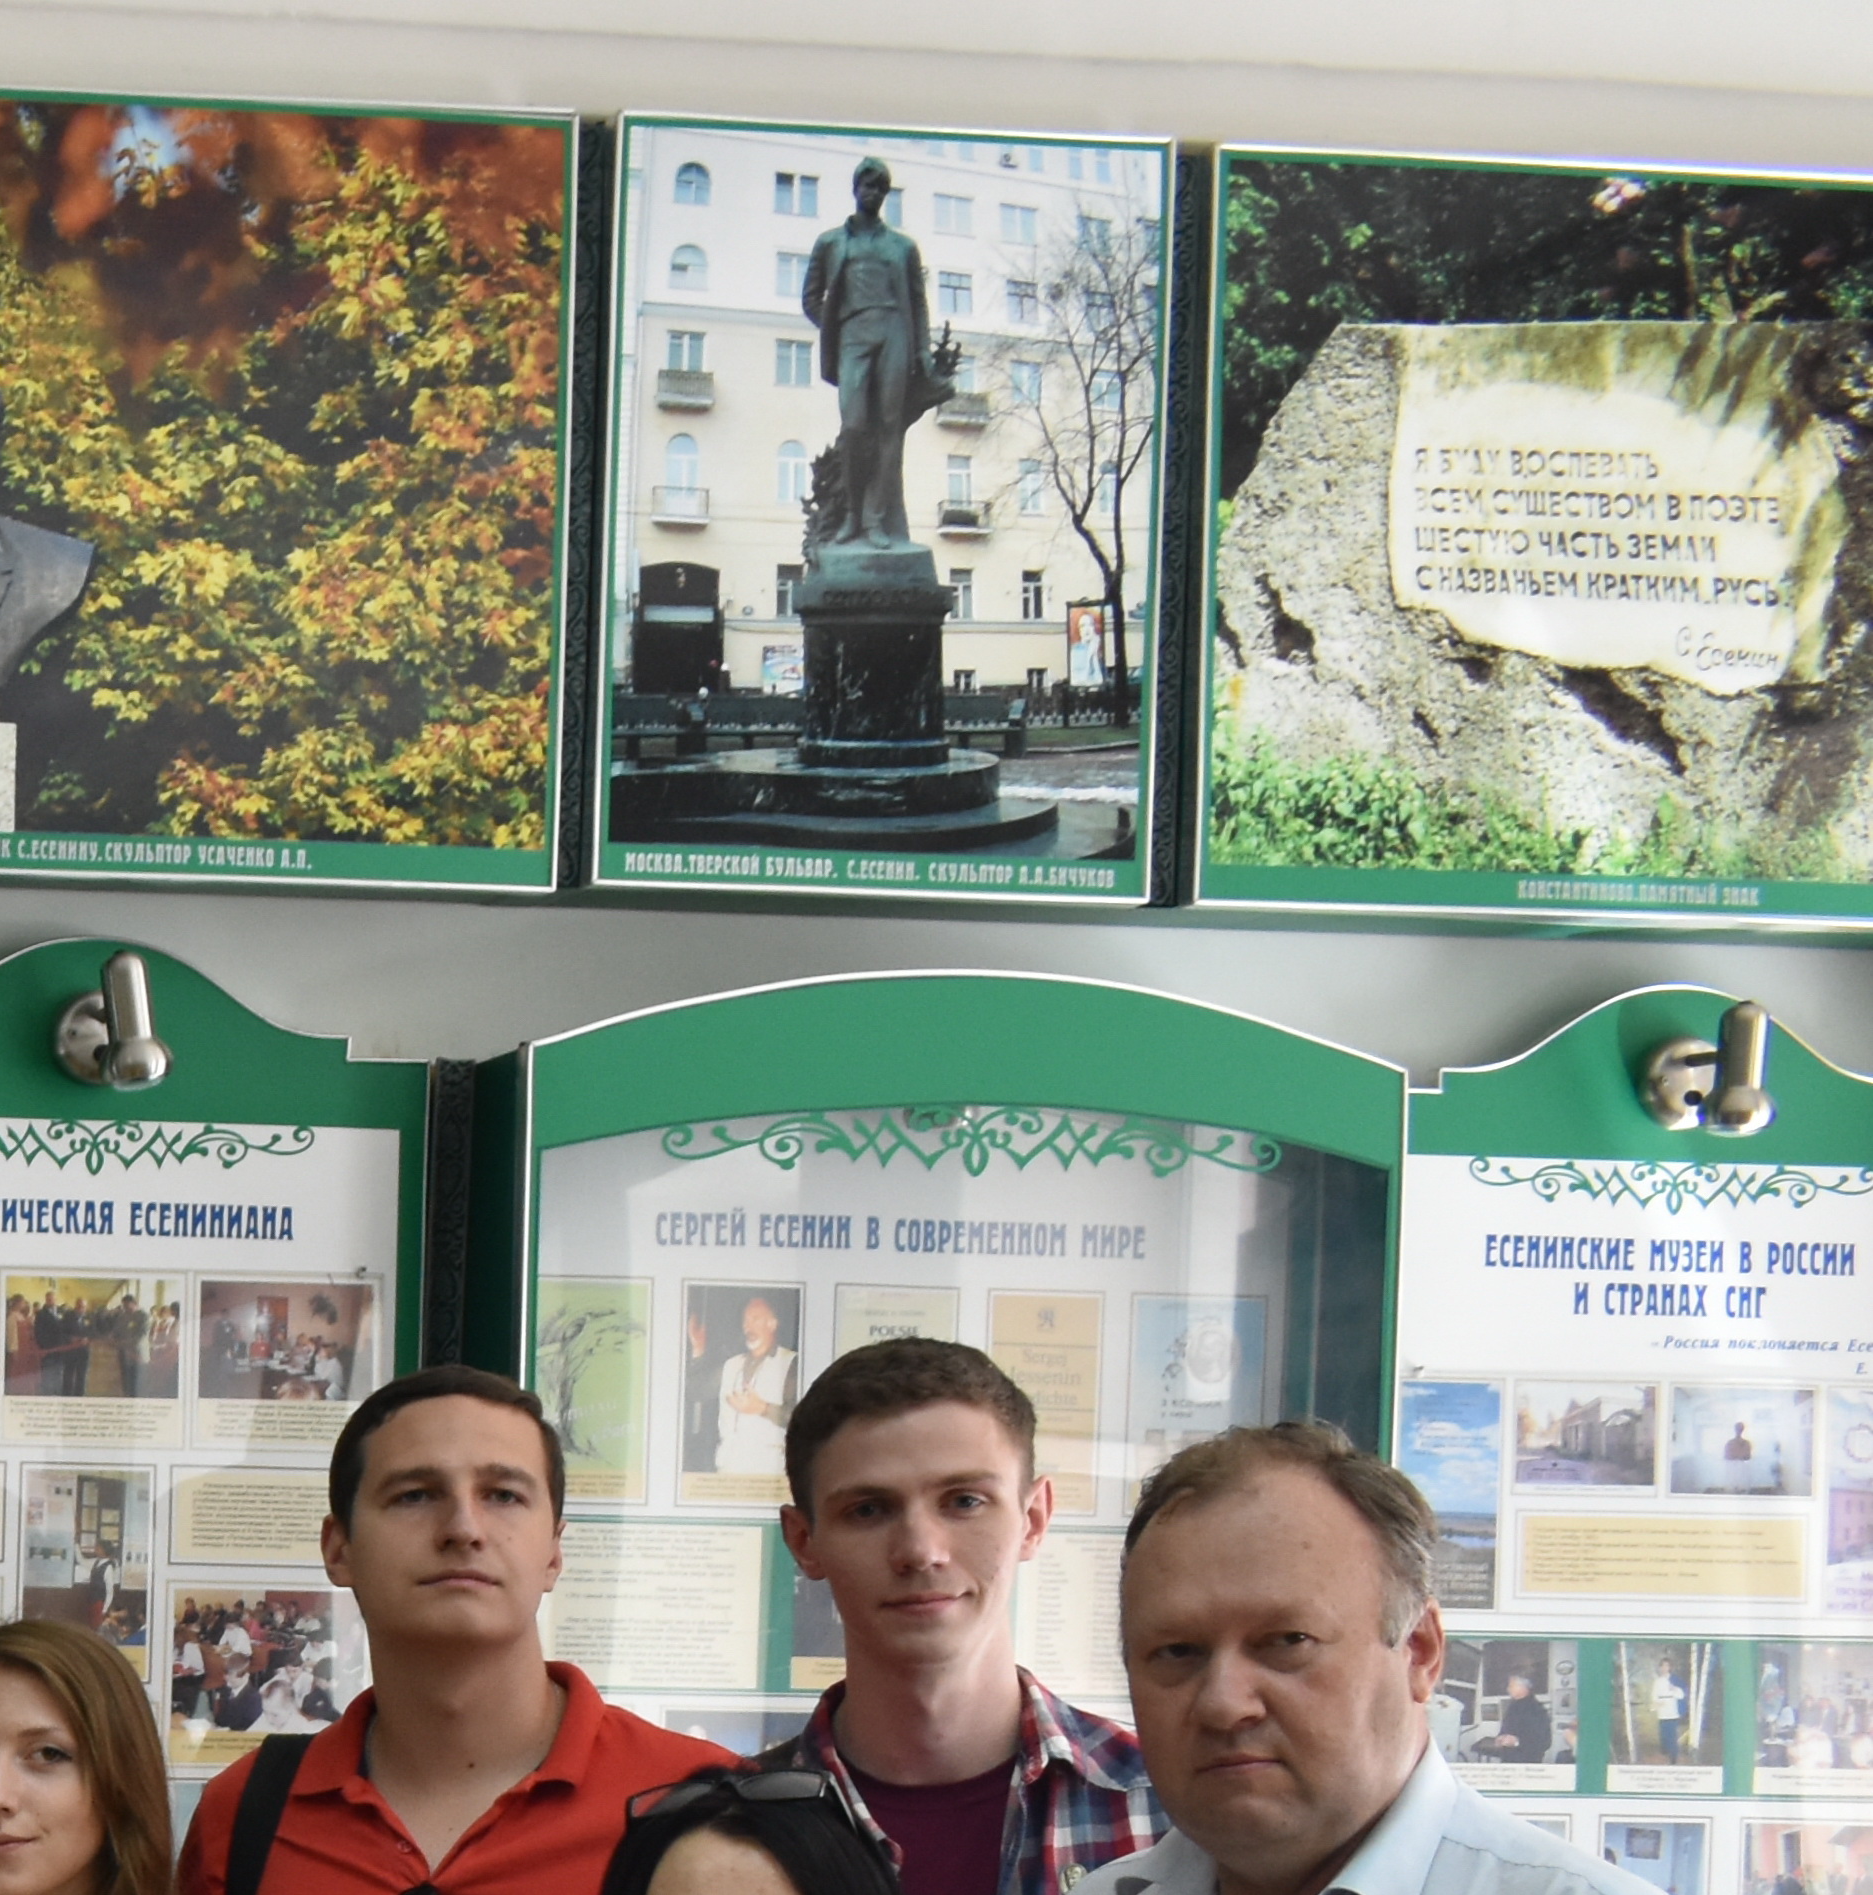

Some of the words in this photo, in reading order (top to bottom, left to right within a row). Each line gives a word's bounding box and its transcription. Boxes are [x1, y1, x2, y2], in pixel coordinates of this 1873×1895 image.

[1415, 448, 1429, 475] Я
[1438, 448, 1500, 476] БУДУ
[1510, 449, 1659, 481] ВОСПЕВАТЬ
[1415, 487, 1483, 516] ВСЕМ
[1492, 489, 1656, 522] СУЩЕСТВОМ
[1666, 494, 1682, 521] В
[1689, 494, 1782, 526] ПОЭТЕ
[1415, 528, 1530, 557] ШЕСТУЮ
[1539, 532, 1621, 560] ЧАСТЬ
[1627, 534, 1718, 563] ЗЕМЛИ
[1415, 565, 1433, 592] С
[1439, 566, 1579, 600] НАЗВАНЬЕМ
[1586, 572, 1700, 603] КРАТКИМ
[198, 844, 275, 868] УСАЧЕНКО
[280, 847, 313, 870] А.П.
[765, 855, 838, 879] БУЛЬВАР.
[846, 859, 921, 881] С.ЕСЕНИН.
[927, 861, 1013, 884] СКУЛЬПТОР
[1018, 865, 1115, 889] А.А.БИЧУКОВ
[1722, 885, 1760, 906] ЗНАК
[129, 1200, 294, 1241] ЕСЕНИНИАНА
[655, 1207, 746, 1248] СЕРГЕЙ
[758, 1212, 851, 1250] ЕСЕНИН
[866, 1216, 881, 1249] В
[894, 1215, 1068, 1258] СОВРЕМЕННОМ
[1081, 1223, 1146, 1260] МИРЕ
[1484, 1233, 1636, 1271] ЕСЕНИНСКИЕ
[1648, 1238, 1725, 1274] МУЗЕИ
[1739, 1241, 1753, 1275] В
[1767, 1241, 1856, 1277] РОССИИ
[1573, 1282, 1589, 1315] И
[1604, 1282, 1708, 1318] СТРАНАХ
[1725, 1283, 1767, 1319] СНГ
[1664, 1335, 1720, 1350] Россия
[1727, 1336, 1840, 1353] поклоняется
[1846, 1338, 1873, 1352] Есе
